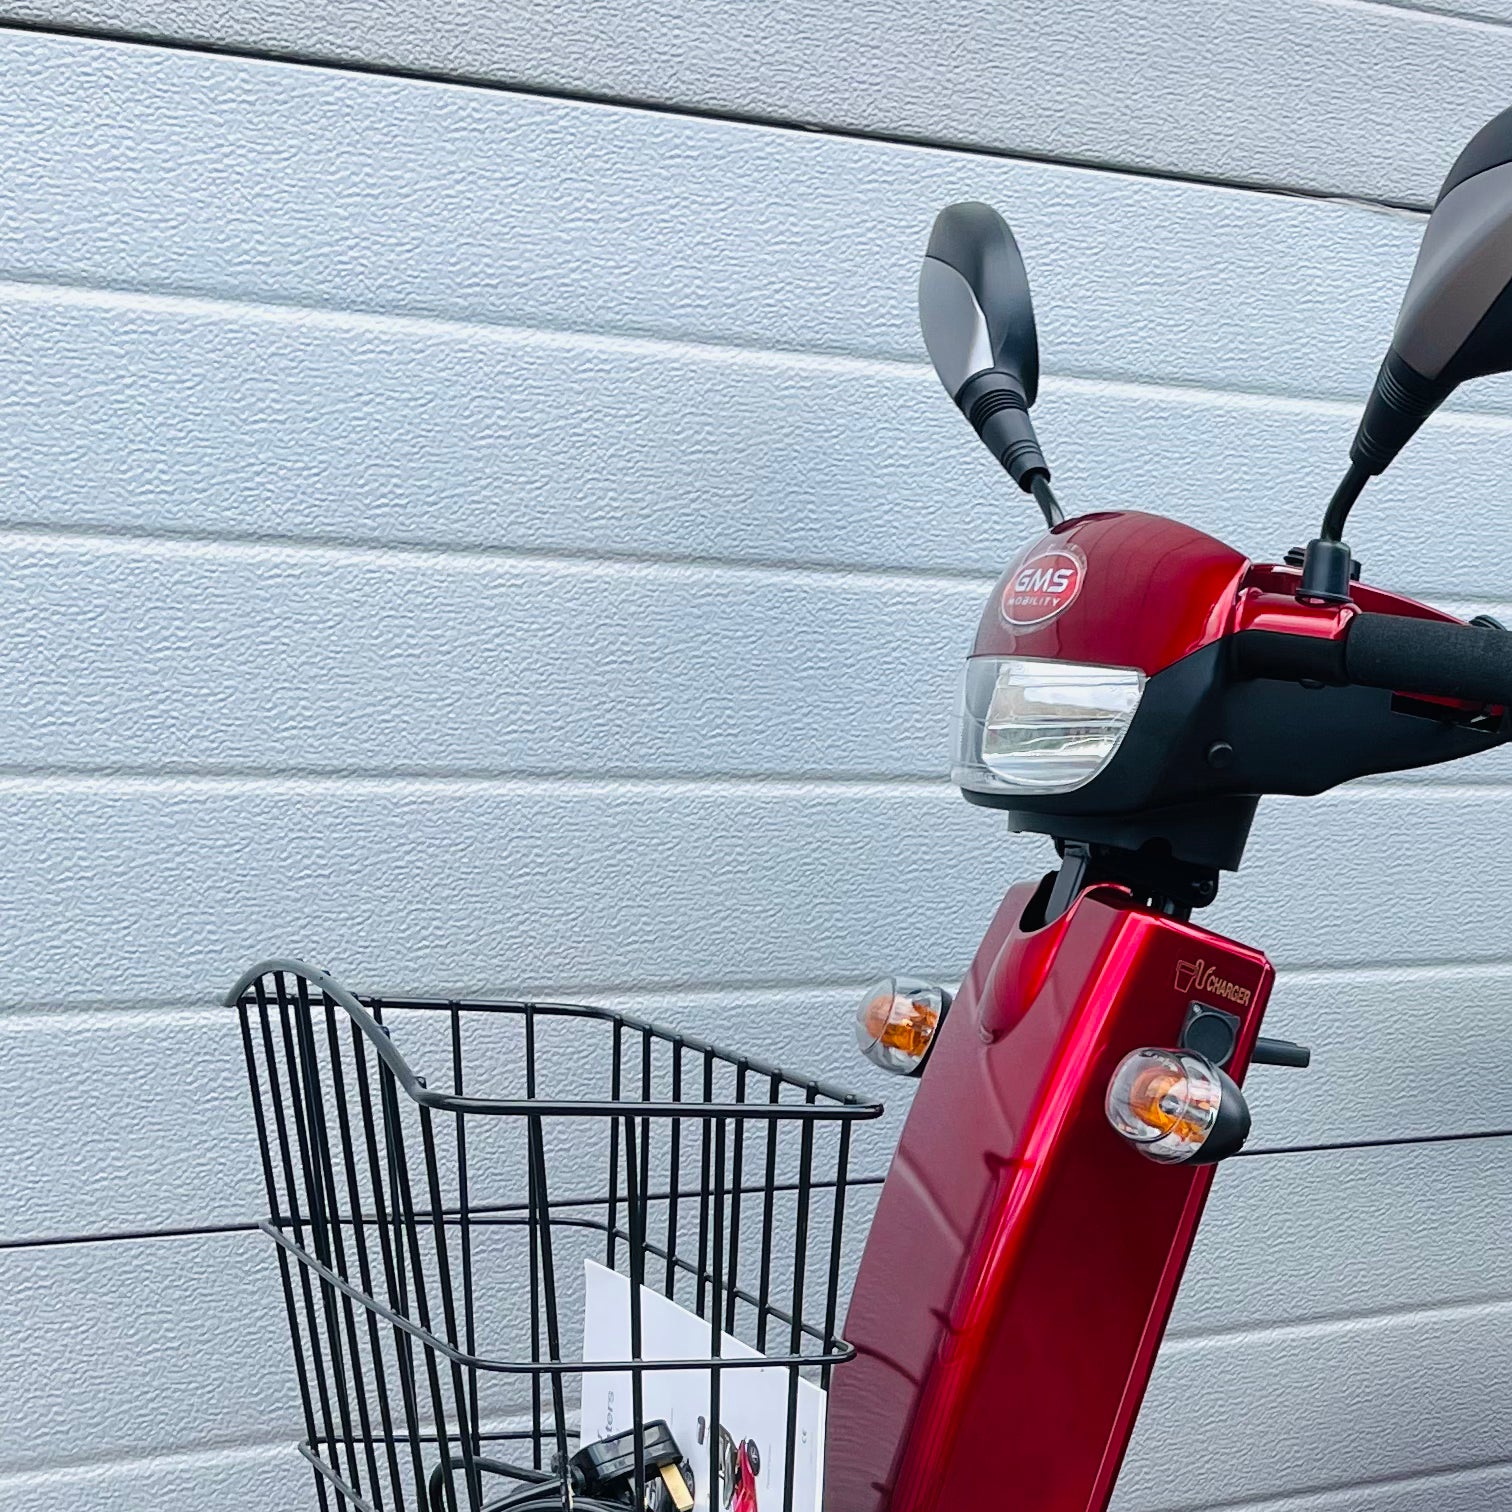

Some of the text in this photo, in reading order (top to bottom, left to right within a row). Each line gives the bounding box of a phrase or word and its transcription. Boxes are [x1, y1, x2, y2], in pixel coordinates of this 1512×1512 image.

[1014, 567, 1076, 593] GMS
[1006, 595, 1062, 607] MOBILITY
[1206, 974, 1252, 1007] CHARGER
